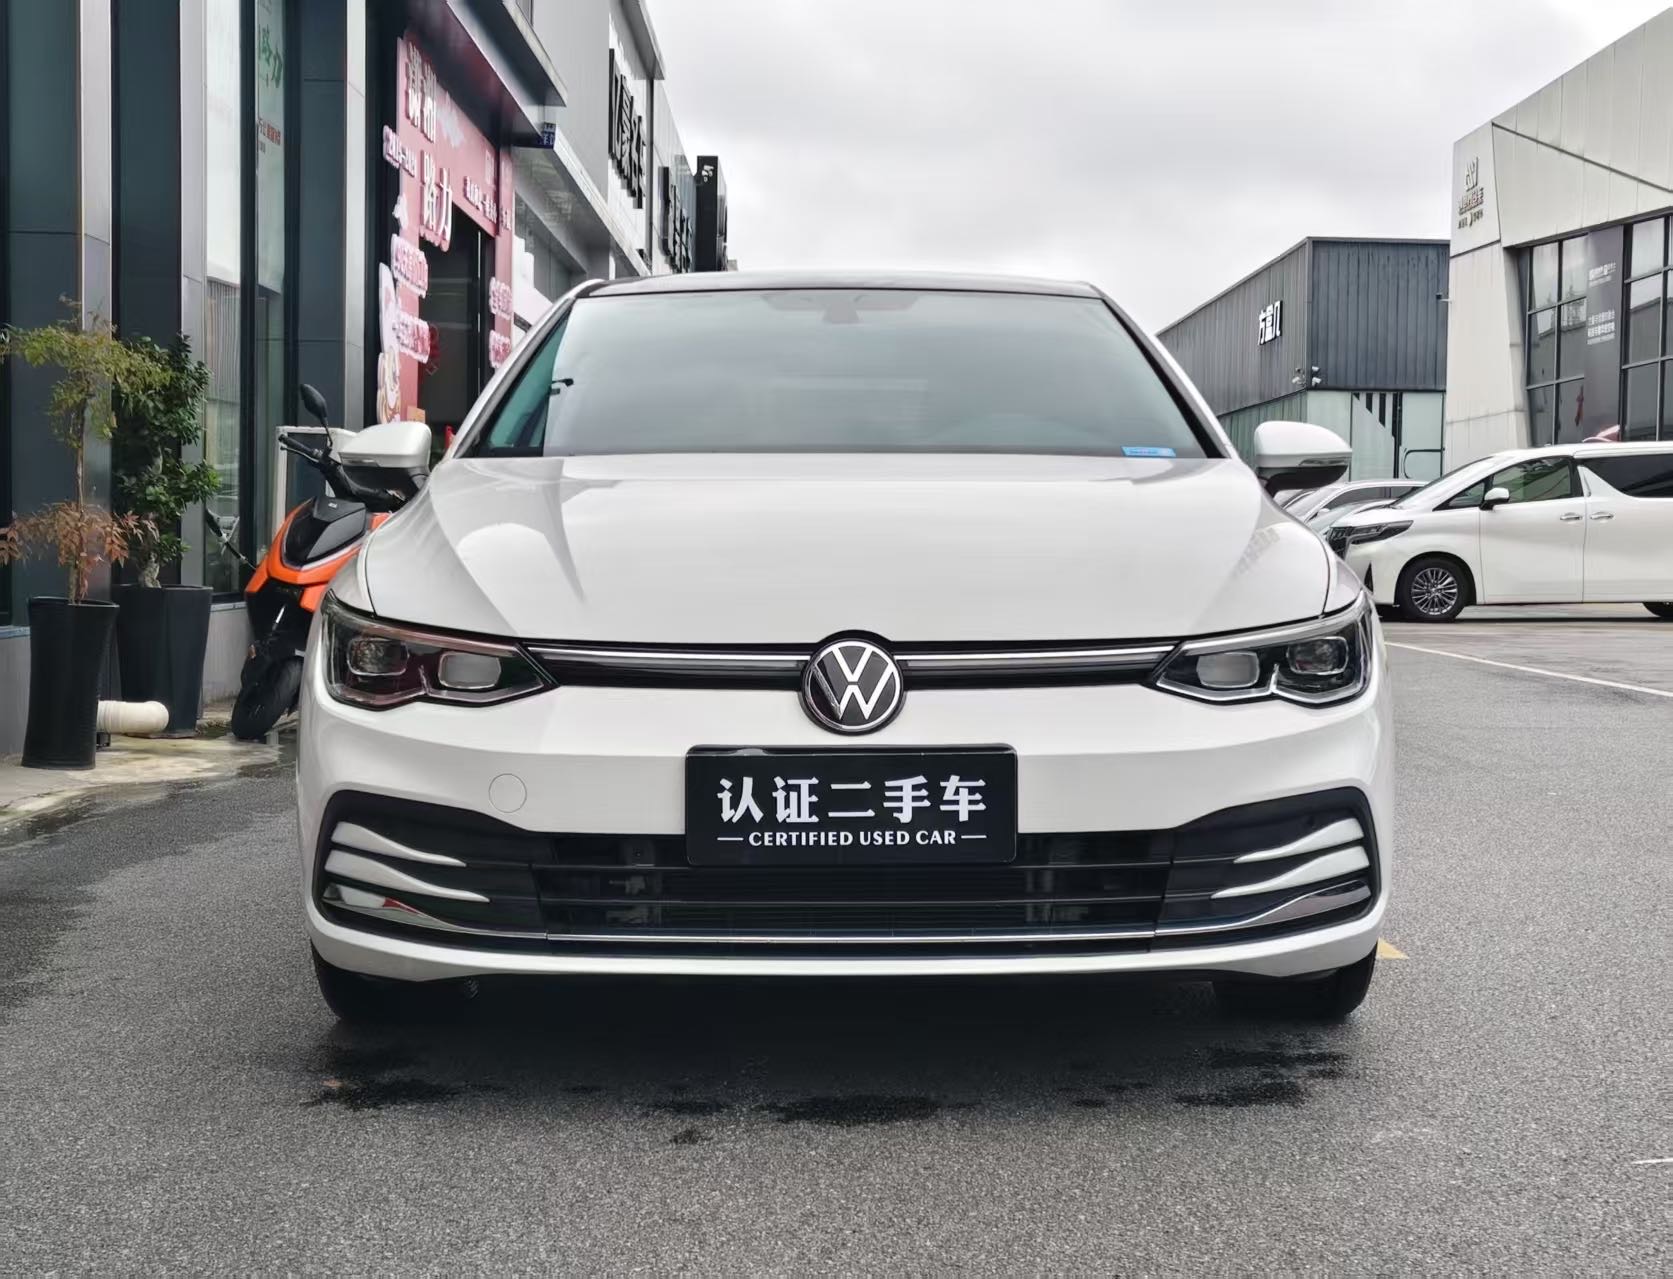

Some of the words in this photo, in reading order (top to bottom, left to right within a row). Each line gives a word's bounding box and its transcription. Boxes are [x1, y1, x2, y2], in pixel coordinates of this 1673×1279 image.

[716, 775, 987, 824] 认证二手车
[749, 831, 854, 847] CERTIFIED
[859, 830, 911, 846] USED
[915, 830, 957, 845] CAR
